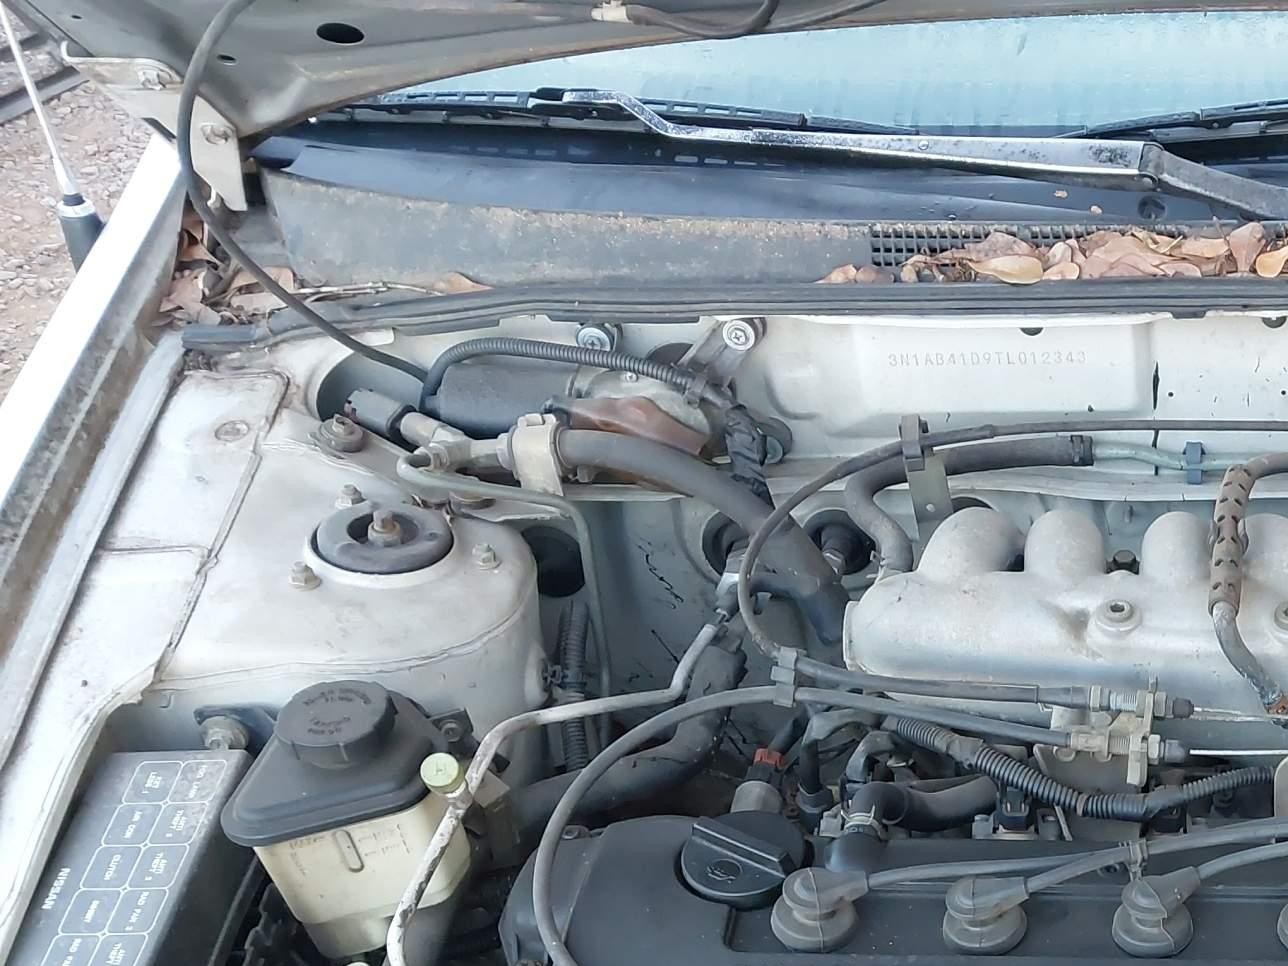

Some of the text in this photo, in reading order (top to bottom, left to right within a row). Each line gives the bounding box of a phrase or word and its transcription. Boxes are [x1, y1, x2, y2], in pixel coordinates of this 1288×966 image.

[888, 351, 1087, 367] 3N1AB41D9TL012343
[104, 854, 121, 880] CLUTCH
[41, 868, 71, 910] NISSAN
[137, 891, 149, 905] RAD
[129, 908, 142, 923] FAN
[69, 938, 82, 953] RAD
